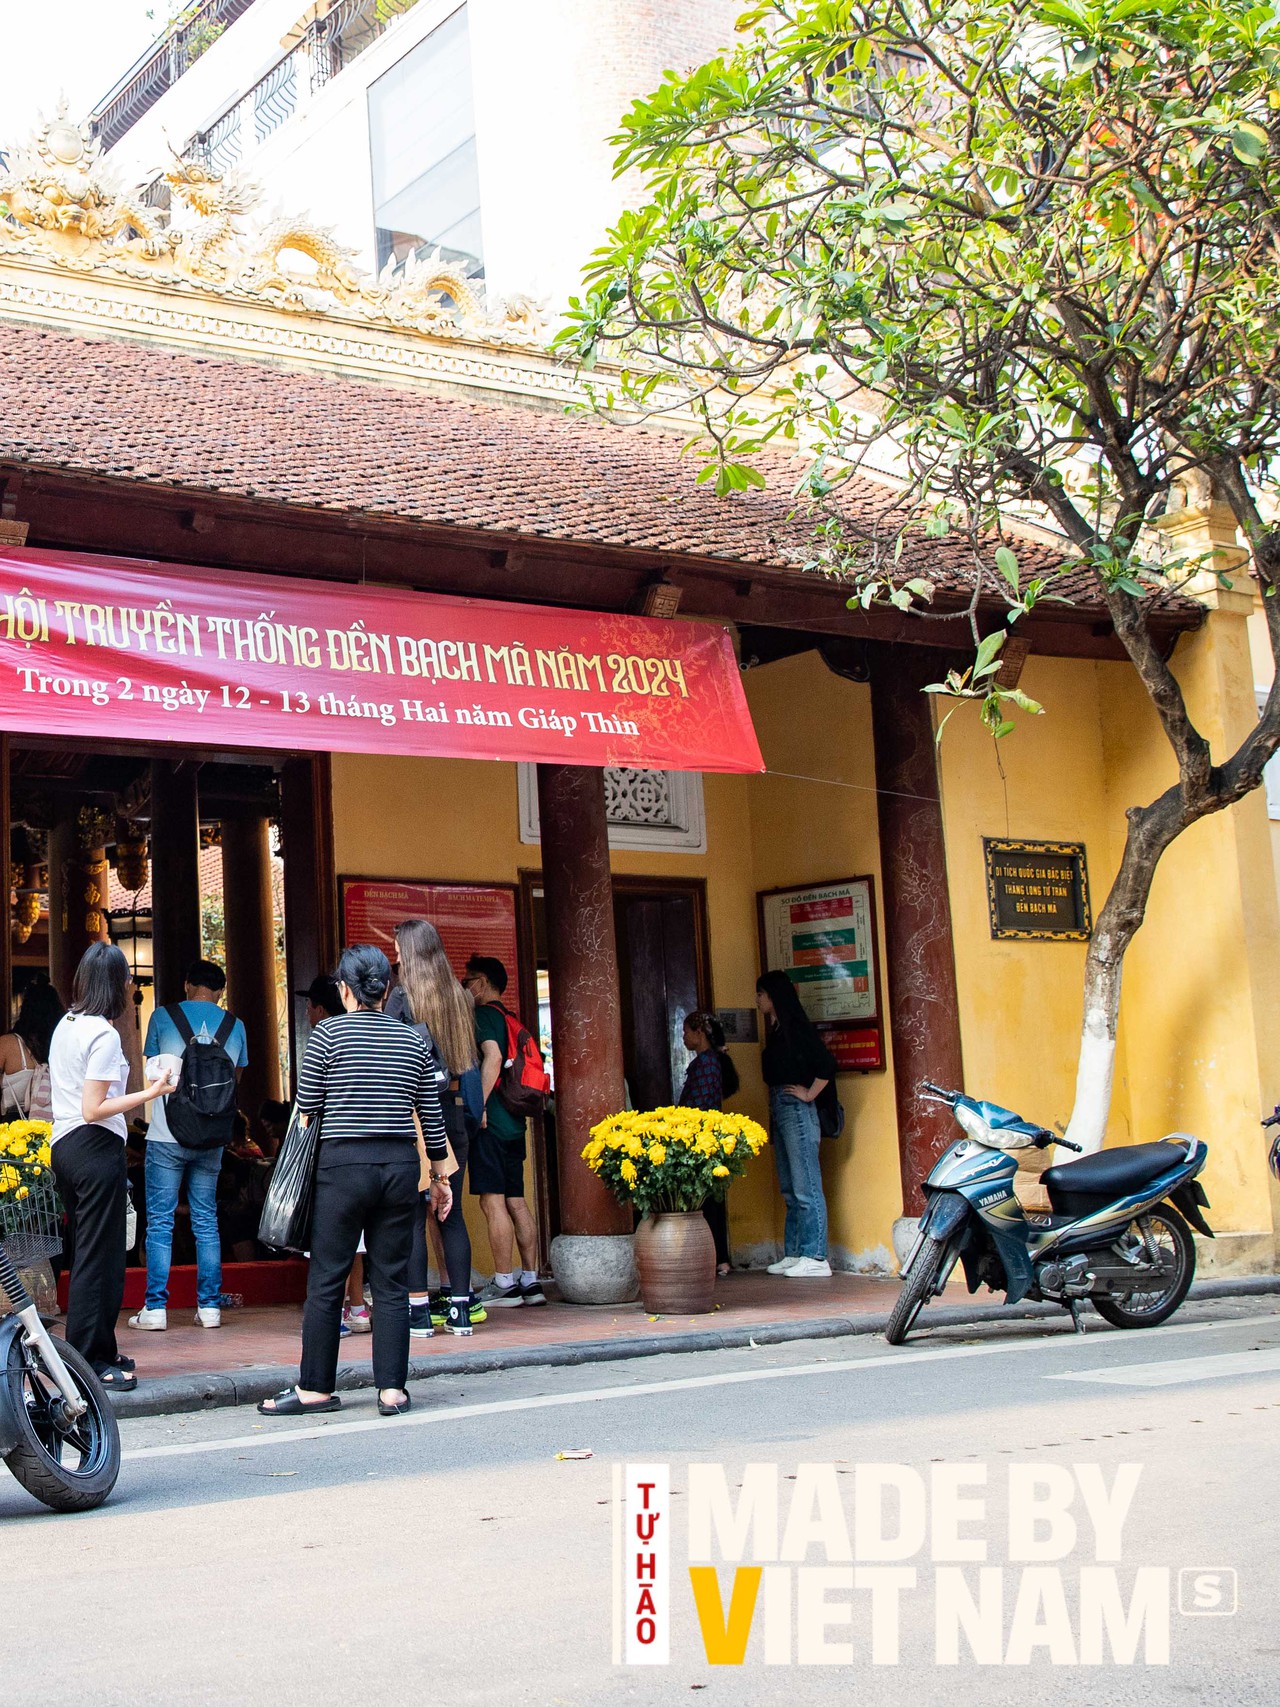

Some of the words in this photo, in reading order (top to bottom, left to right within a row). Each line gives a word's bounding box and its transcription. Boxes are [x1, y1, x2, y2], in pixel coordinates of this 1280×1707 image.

[54, 599, 203, 658] TRUYỀN
[207, 610, 322, 669] THỐNG
[325, 620, 395, 675] ĐỀN
[396, 635, 482, 685] BẠCH
[483, 641, 535, 687] MÃ
[535, 645, 608, 693] NĂM
[606, 653, 690, 698] 2024
[16, 667, 110, 706] Trong
[116, 677, 134, 701] 2
[142, 681, 211, 713] ngày
[220, 685, 252, 709] 12
[280, 690, 312, 714] 13
[318, 692, 397, 726] tháng
[399, 699, 450, 723] Hai
[455, 704, 513, 727] năm
[517, 707, 578, 737] Giáp
[580, 711, 640, 736] Thìn
[995, 867, 1002, 876] DI
[1004, 863, 1017, 877] TÍCH
[1036, 868, 1046, 879] GIA
[1026, 885, 1042, 895] LONG
[979, 1190, 1007, 1206] YAMAHA
